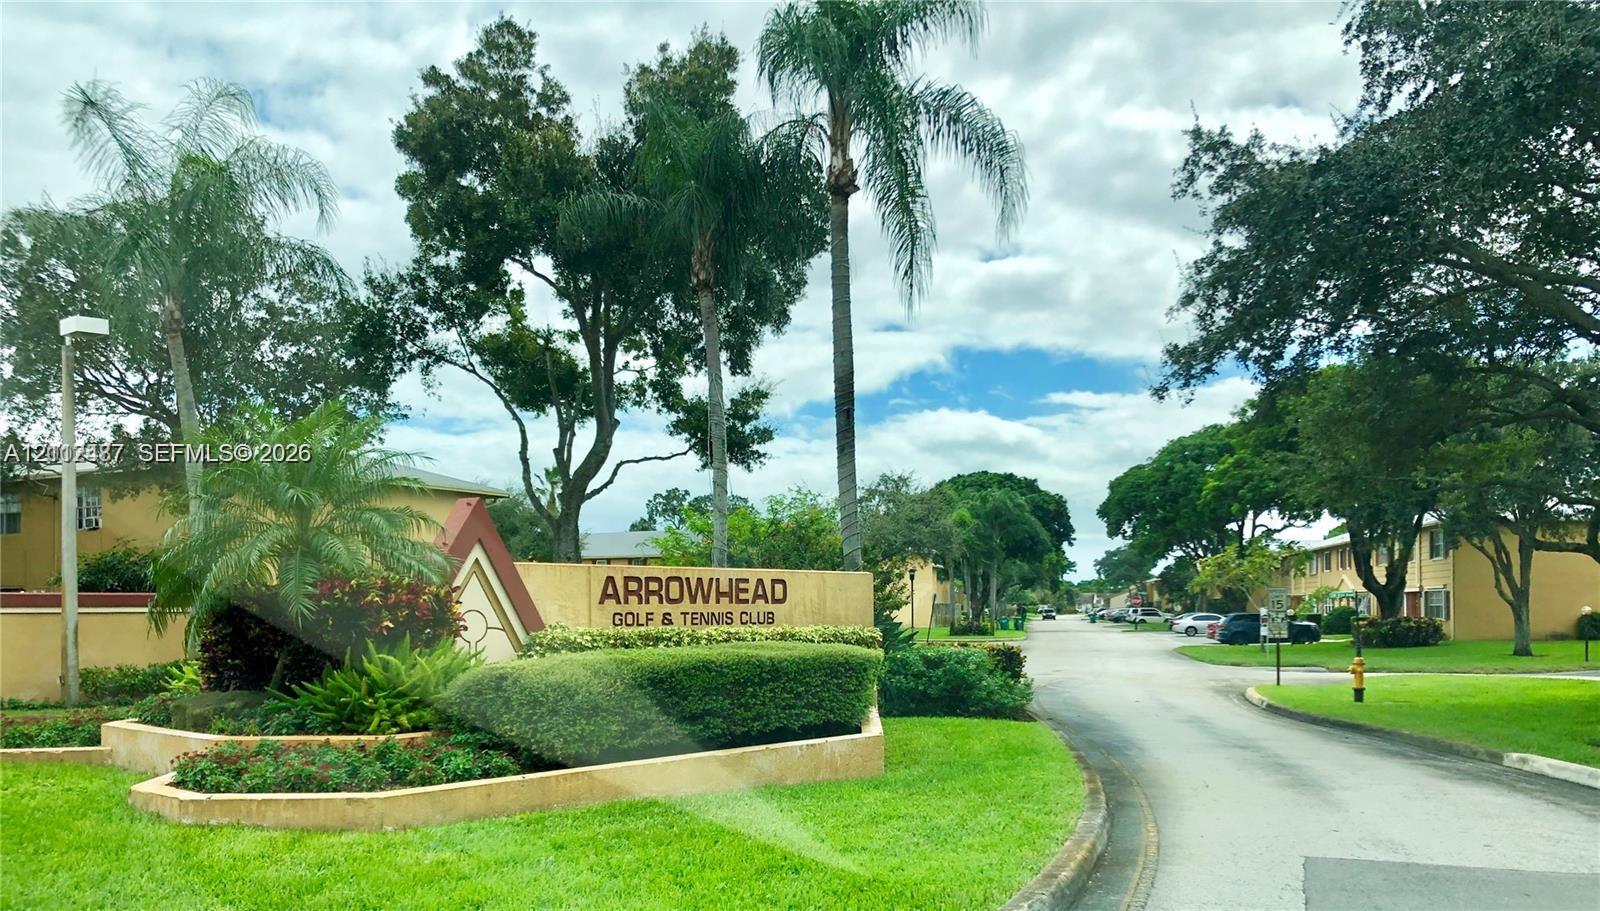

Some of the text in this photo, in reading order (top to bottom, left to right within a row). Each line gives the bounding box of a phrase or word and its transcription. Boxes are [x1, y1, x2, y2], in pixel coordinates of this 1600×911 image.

[598, 575, 788, 605] ARROWHEAD
[1271, 600, 1285, 610] 15
[612, 611, 775, 627] GOLF & TENNIS CLUB
